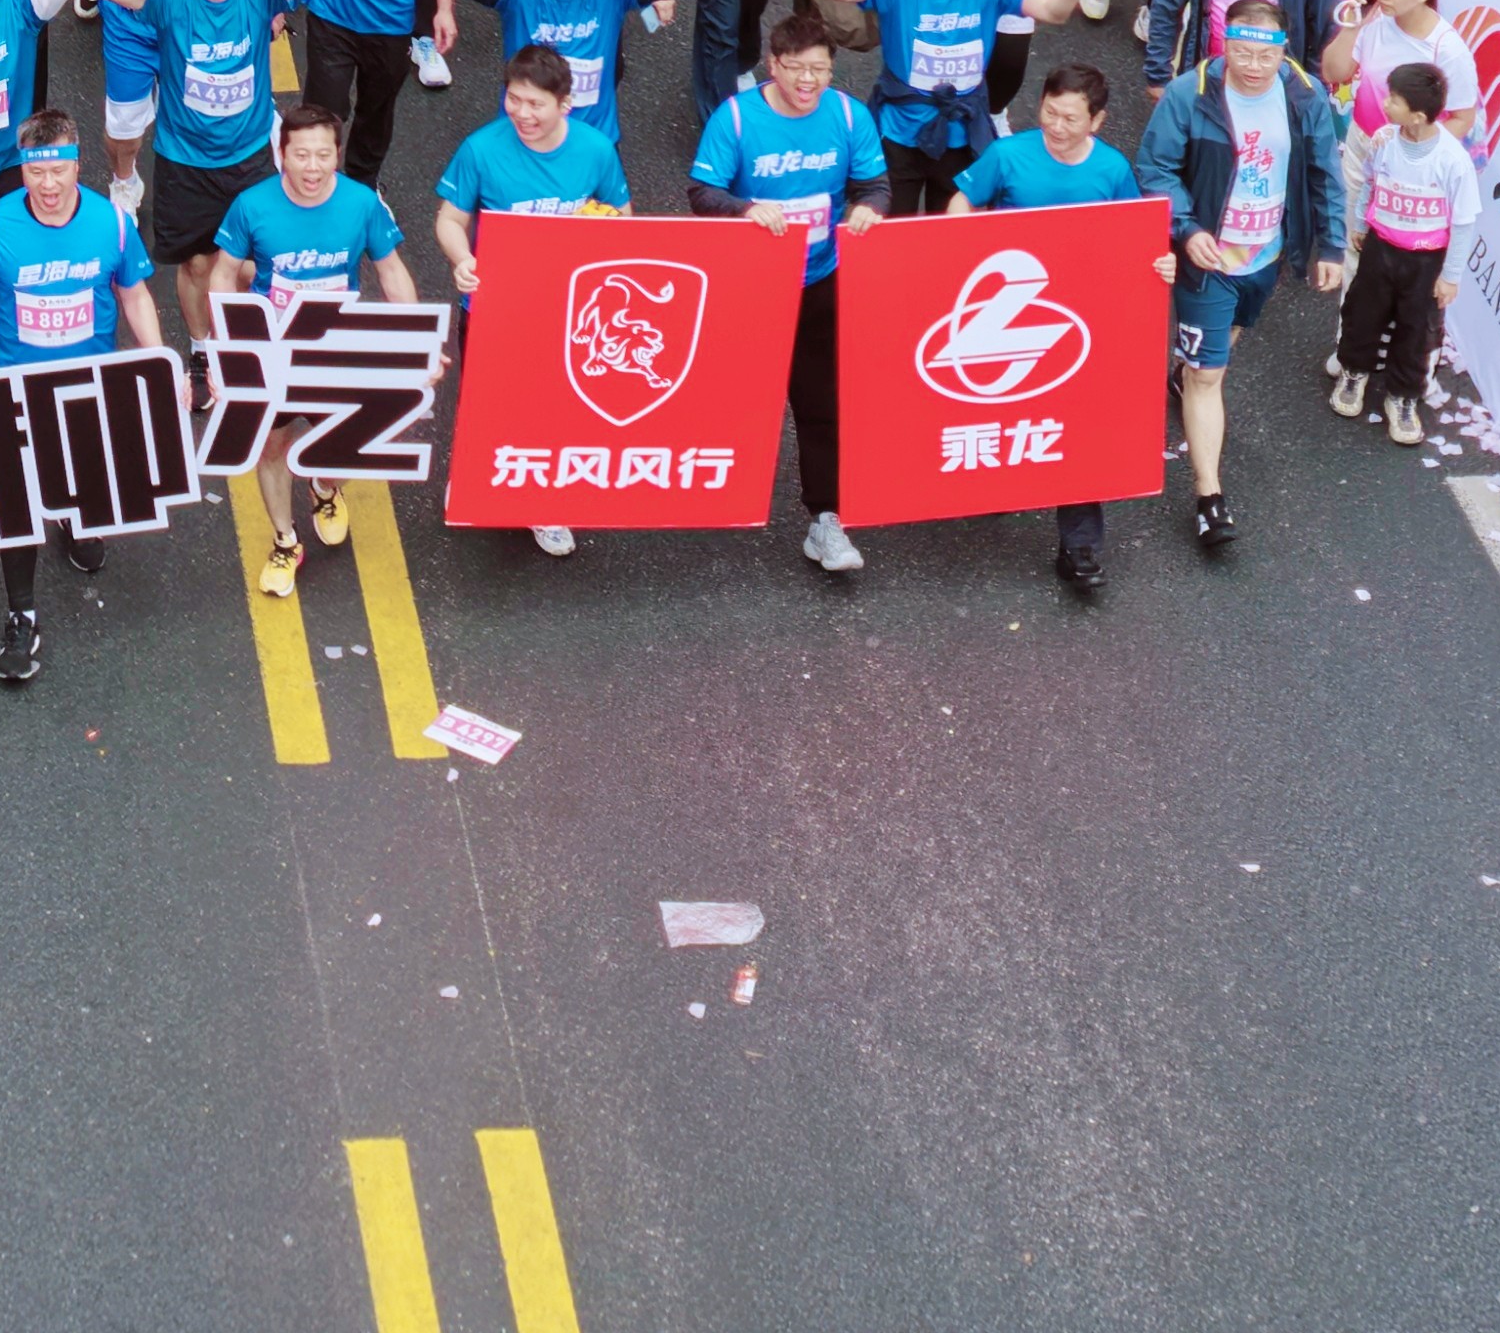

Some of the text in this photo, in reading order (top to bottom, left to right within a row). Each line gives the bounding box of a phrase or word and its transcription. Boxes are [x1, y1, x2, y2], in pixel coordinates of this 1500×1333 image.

[491, 444, 735, 491] 东风风行
[940, 420, 1064, 473] 乘龙
